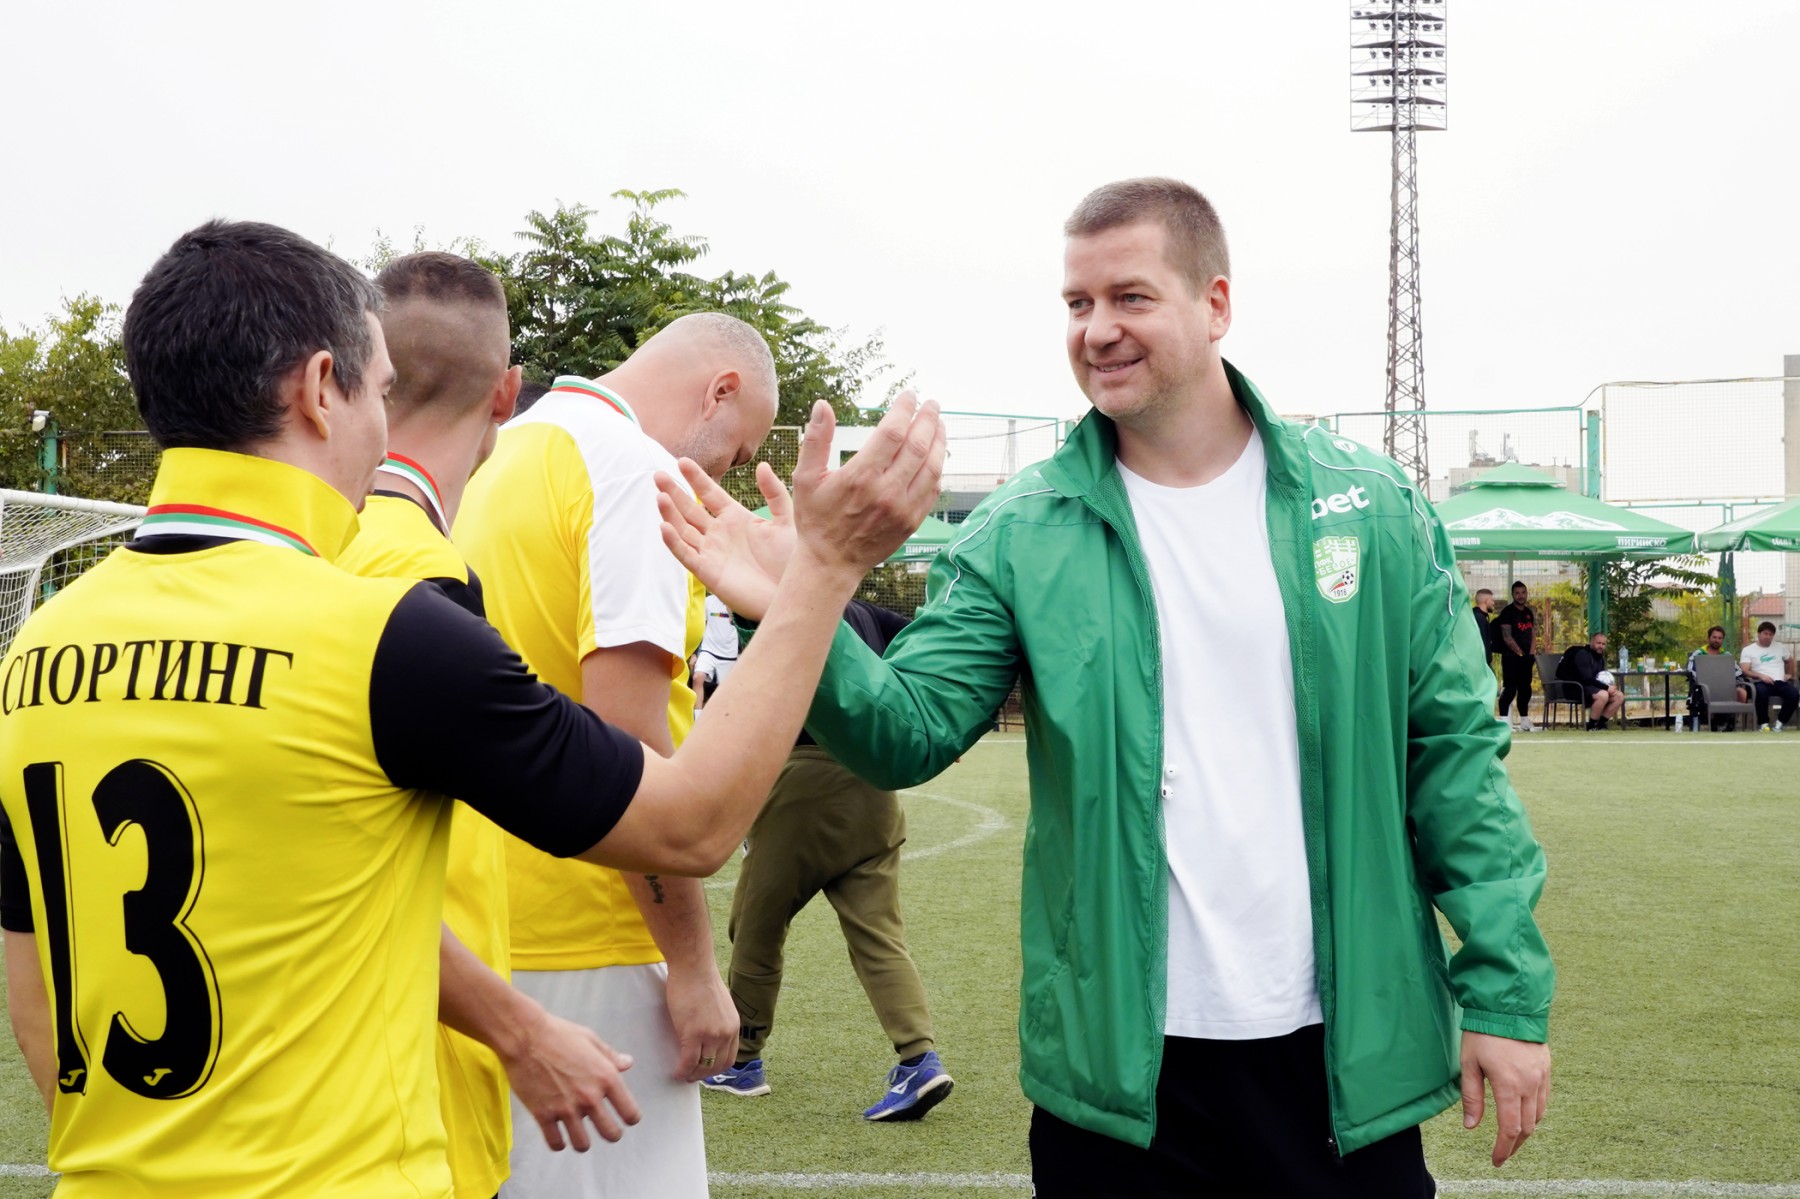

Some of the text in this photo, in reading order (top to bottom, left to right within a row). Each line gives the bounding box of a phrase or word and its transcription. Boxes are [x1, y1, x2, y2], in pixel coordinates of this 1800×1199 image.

[1617, 538, 1667, 547] ПИРИНСКО
[1333, 588, 1348, 597] 1916
[2, 639, 294, 716] СПОРТИНГ
[23, 759, 222, 1099] 13
